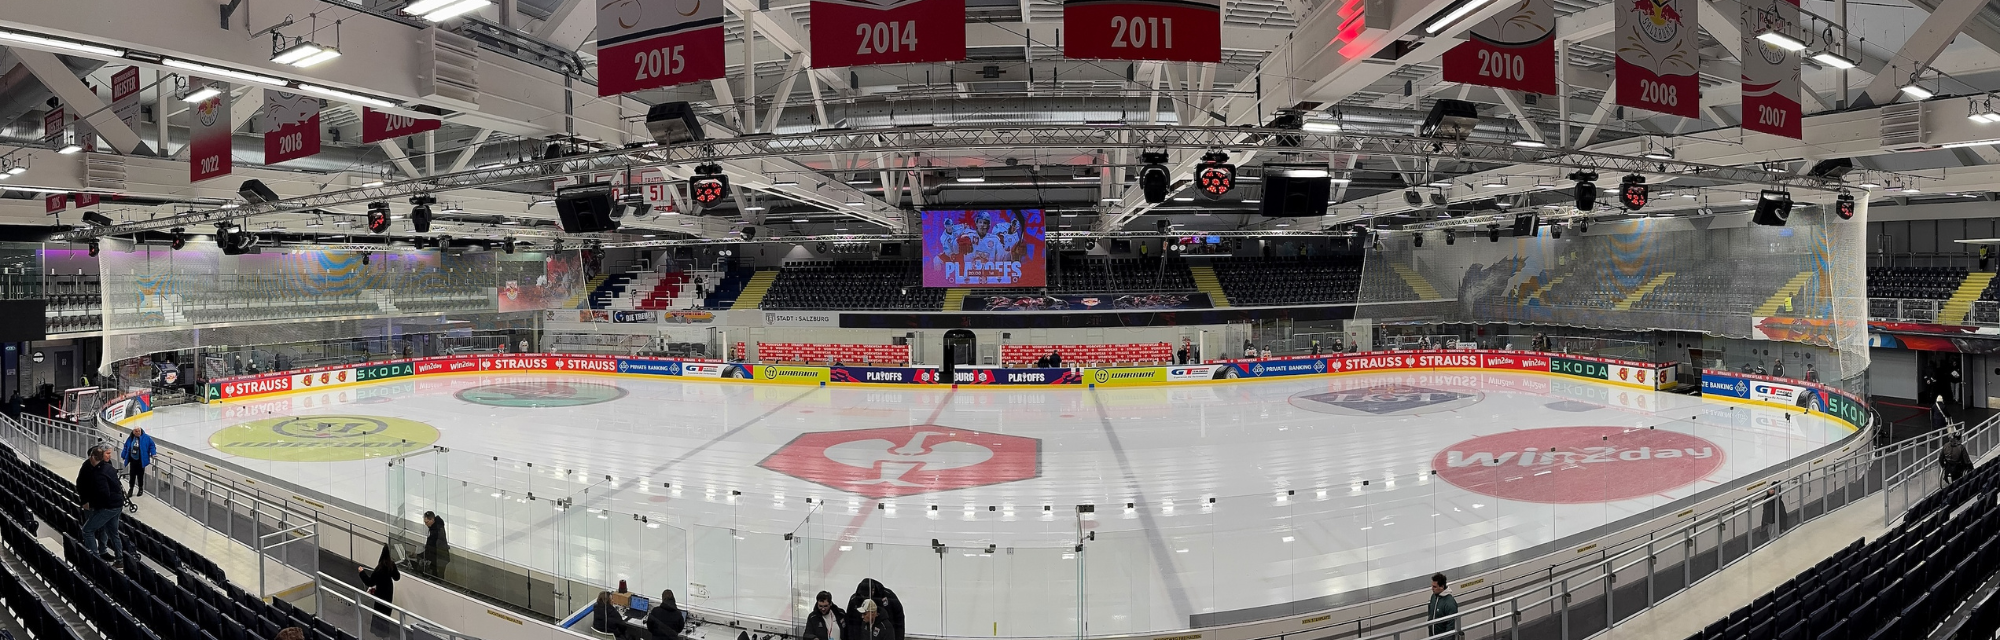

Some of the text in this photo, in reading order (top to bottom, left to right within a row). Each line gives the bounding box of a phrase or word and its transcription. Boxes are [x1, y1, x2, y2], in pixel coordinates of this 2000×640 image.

[856, 20, 918, 55] 2014
[1110, 16, 1173, 48] 2011
[634, 45, 685, 80] 2015
[1478, 49, 1524, 81] 2010
[114, 76, 136, 97] MEISTER
[1640, 79, 1677, 106] 2008
[1759, 105, 1786, 128] 2007
[280, 132, 302, 154] 2018
[201, 155, 219, 174] 2022
[650, 185, 663, 201] 51
[495, 359, 548, 368] STRAUSS
[568, 360, 615, 370] STRAUSS
[1346, 357, 1402, 370] STRAUSS
[1420, 356, 1476, 366] STRAUSS
[867, 372, 902, 381] PLAYOFFS
[1008, 373, 1045, 382] PLAYOFFS
[236, 378, 288, 395] STRAUSS
[1710, 382, 1733, 390] BANKING
